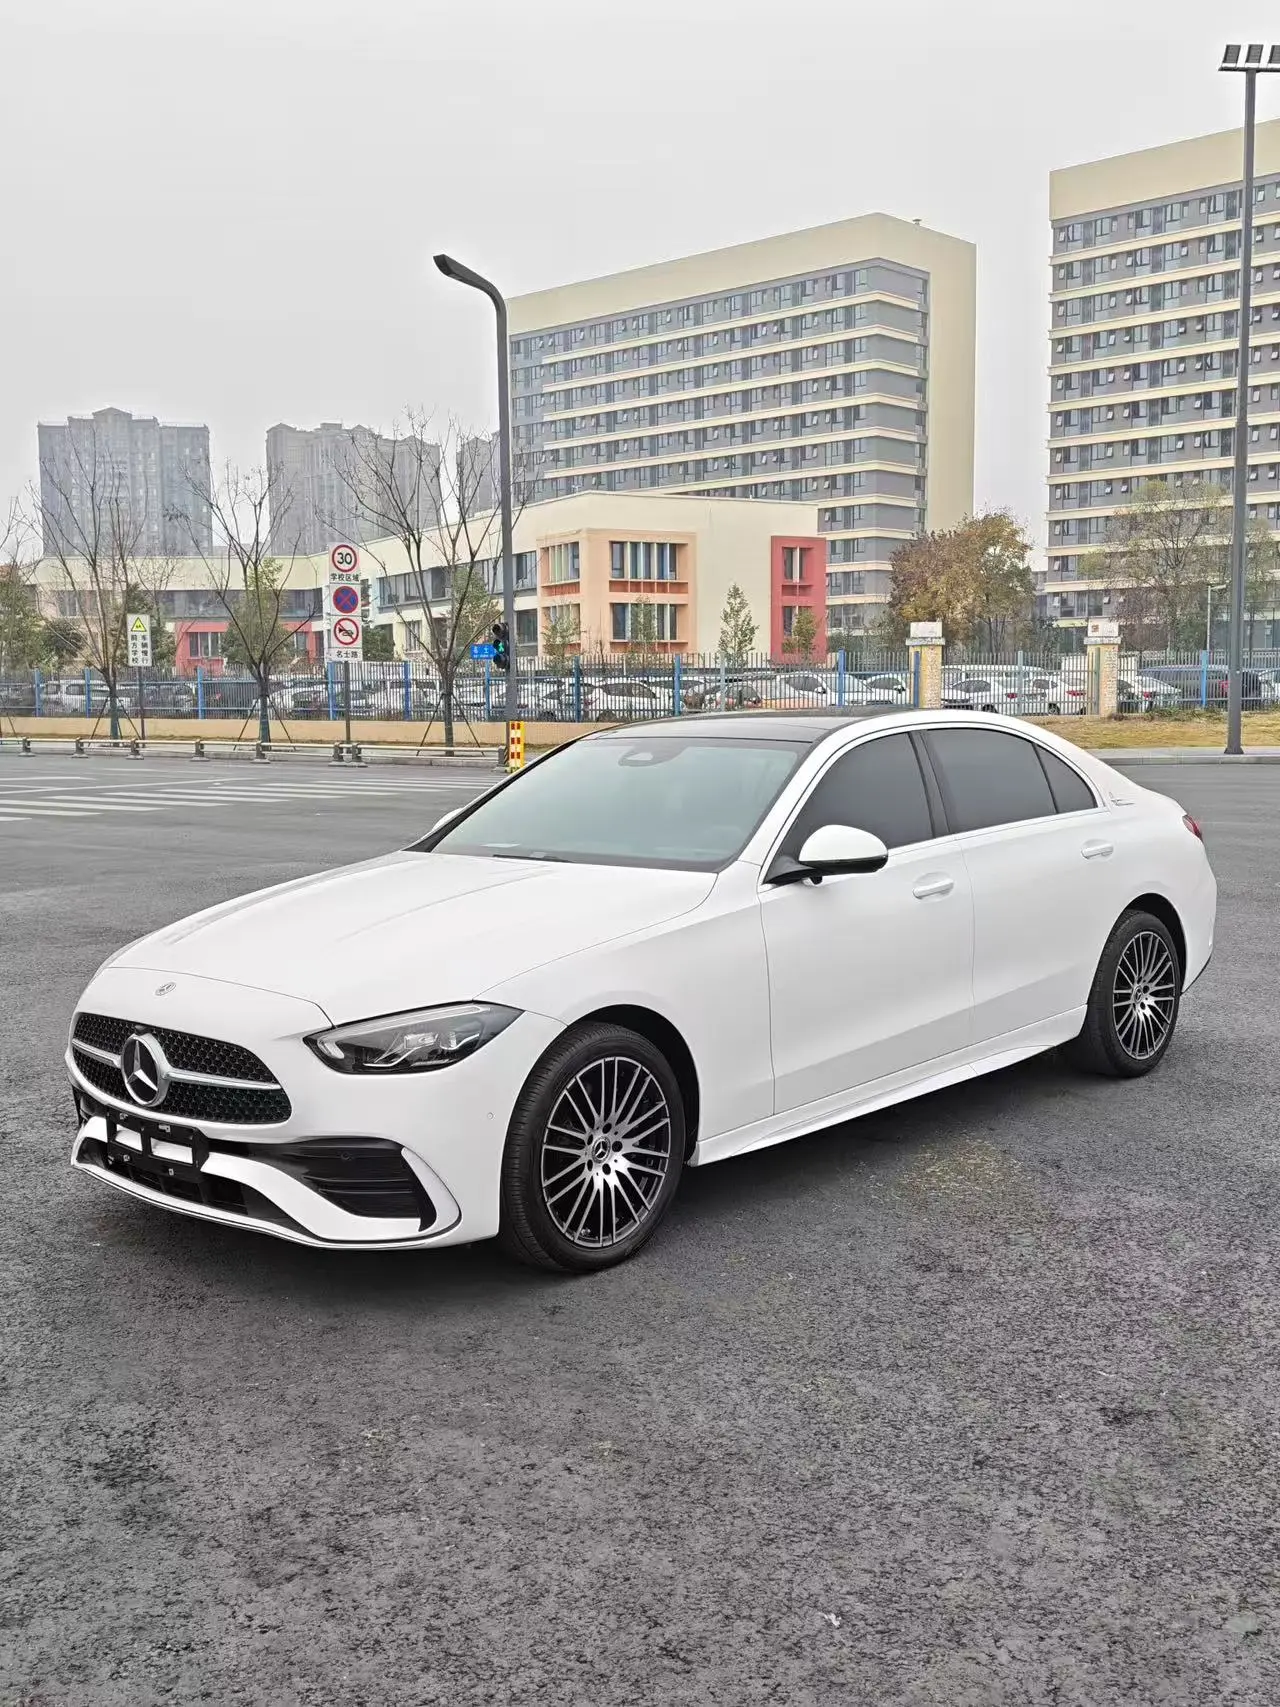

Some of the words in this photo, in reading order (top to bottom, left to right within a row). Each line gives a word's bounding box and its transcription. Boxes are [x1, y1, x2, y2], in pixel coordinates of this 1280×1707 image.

[337, 552, 352, 565] 30
[331, 573, 360, 582] 学校区域
[131, 634, 139, 664] 前方学校
[141, 634, 149, 664] 车辆慢行
[336, 650, 358, 658] 名士路
